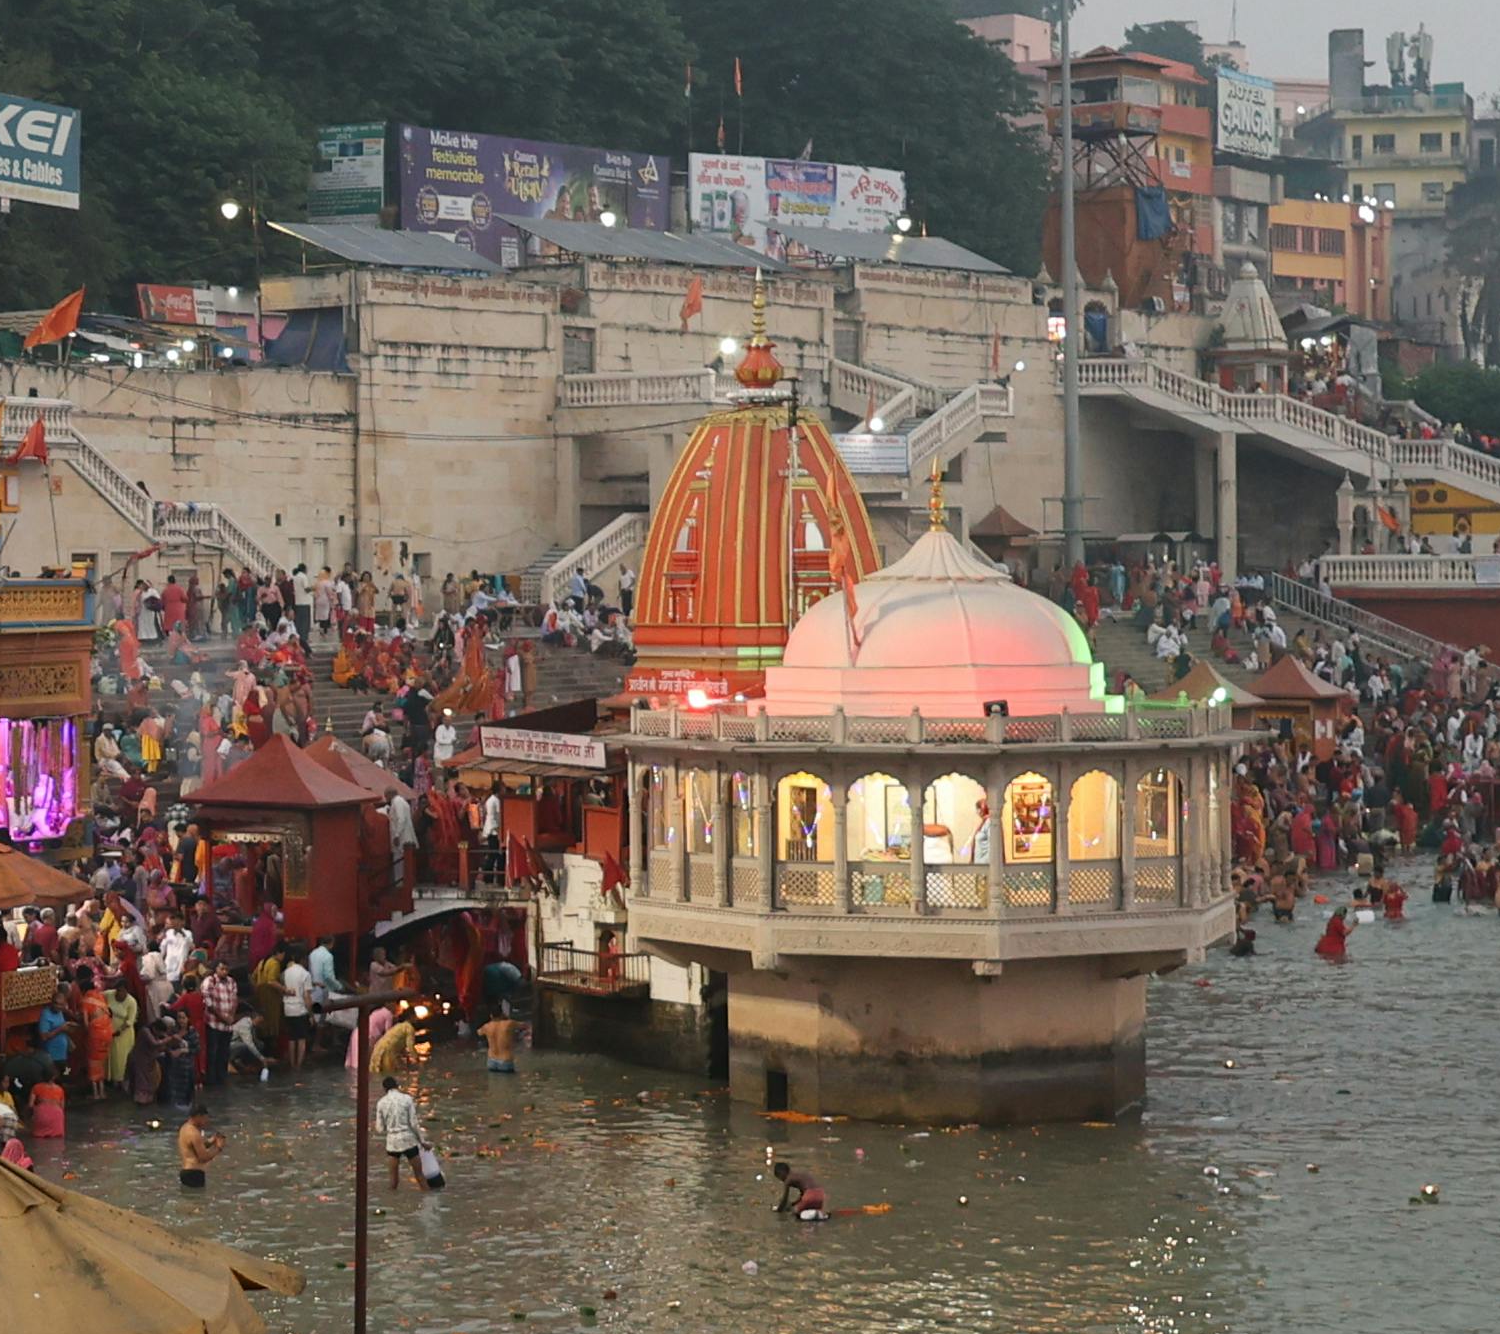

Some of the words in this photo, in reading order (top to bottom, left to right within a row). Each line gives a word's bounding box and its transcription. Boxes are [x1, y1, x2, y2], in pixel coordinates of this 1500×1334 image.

[1221, 101, 1273, 142] GANGA
[429, 130, 460, 148] Make
[461, 133, 479, 150] the
[11, 158, 21, 179] &
[22, 158, 64, 187] Cables
[425, 168, 485, 185] memorable
